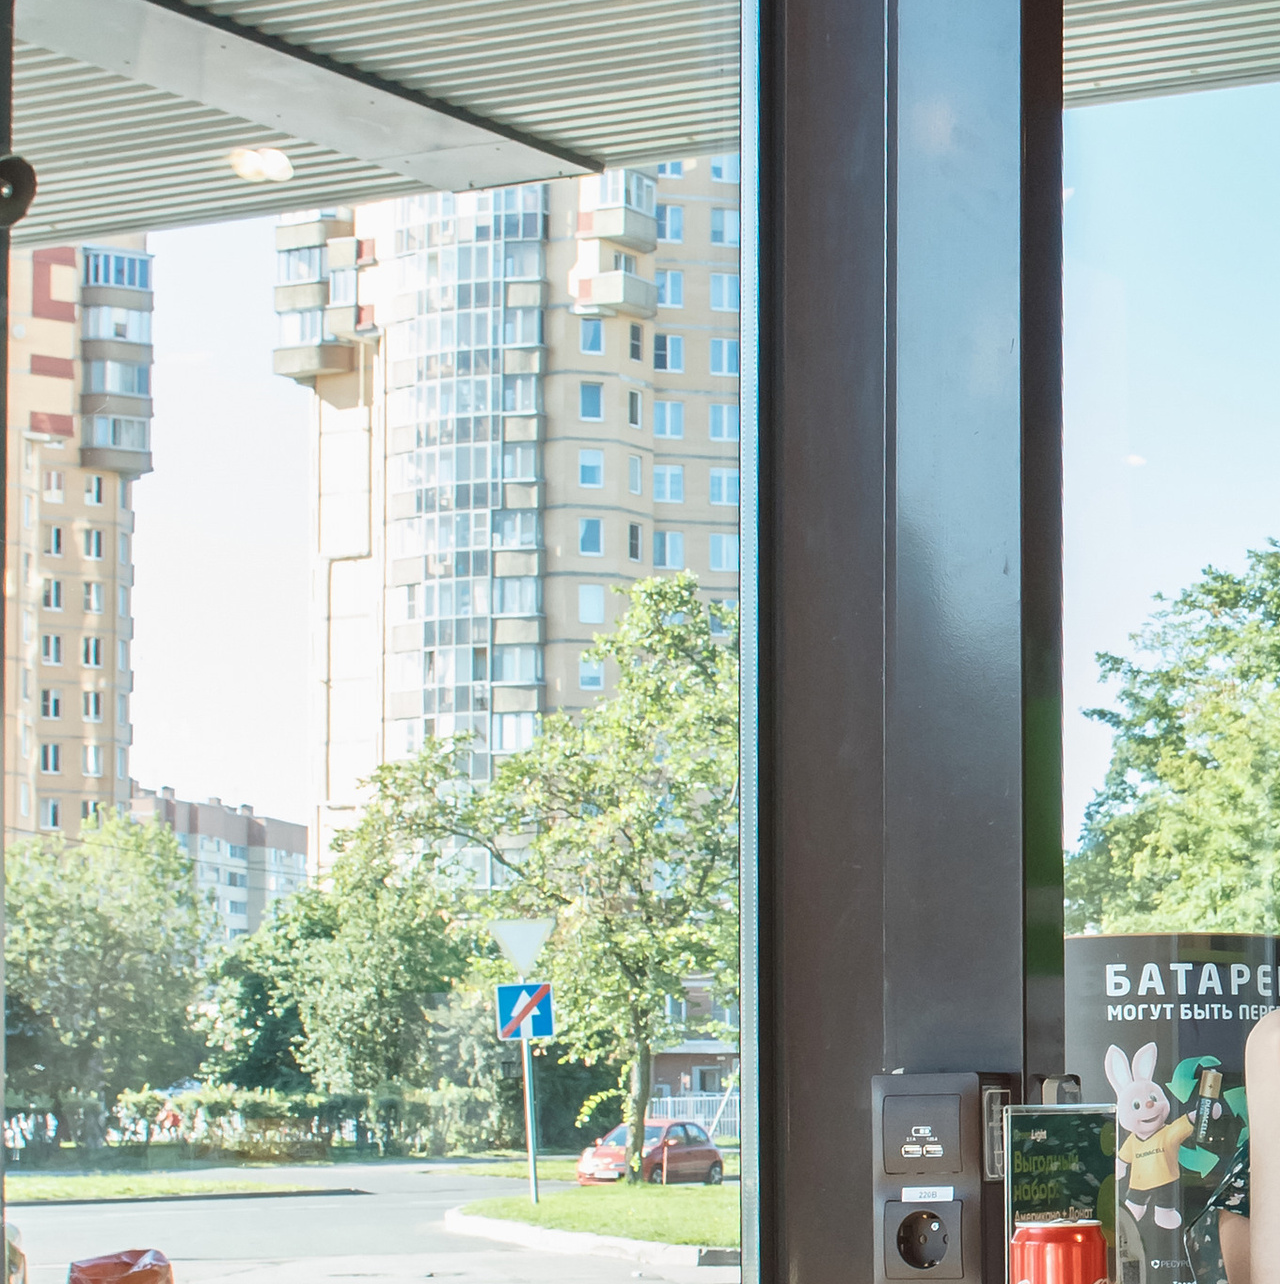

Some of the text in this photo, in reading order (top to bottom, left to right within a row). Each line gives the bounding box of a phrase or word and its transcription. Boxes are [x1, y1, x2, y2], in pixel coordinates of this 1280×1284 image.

[1107, 1003, 1174, 1021] МОГУТ
[1180, 1003, 1233, 1021] БЫТЬ
[1135, 1147, 1165, 1159] DURACELL
[1014, 1150, 1079, 1174] Выгодный
[1014, 1210, 1060, 1221] Американо
